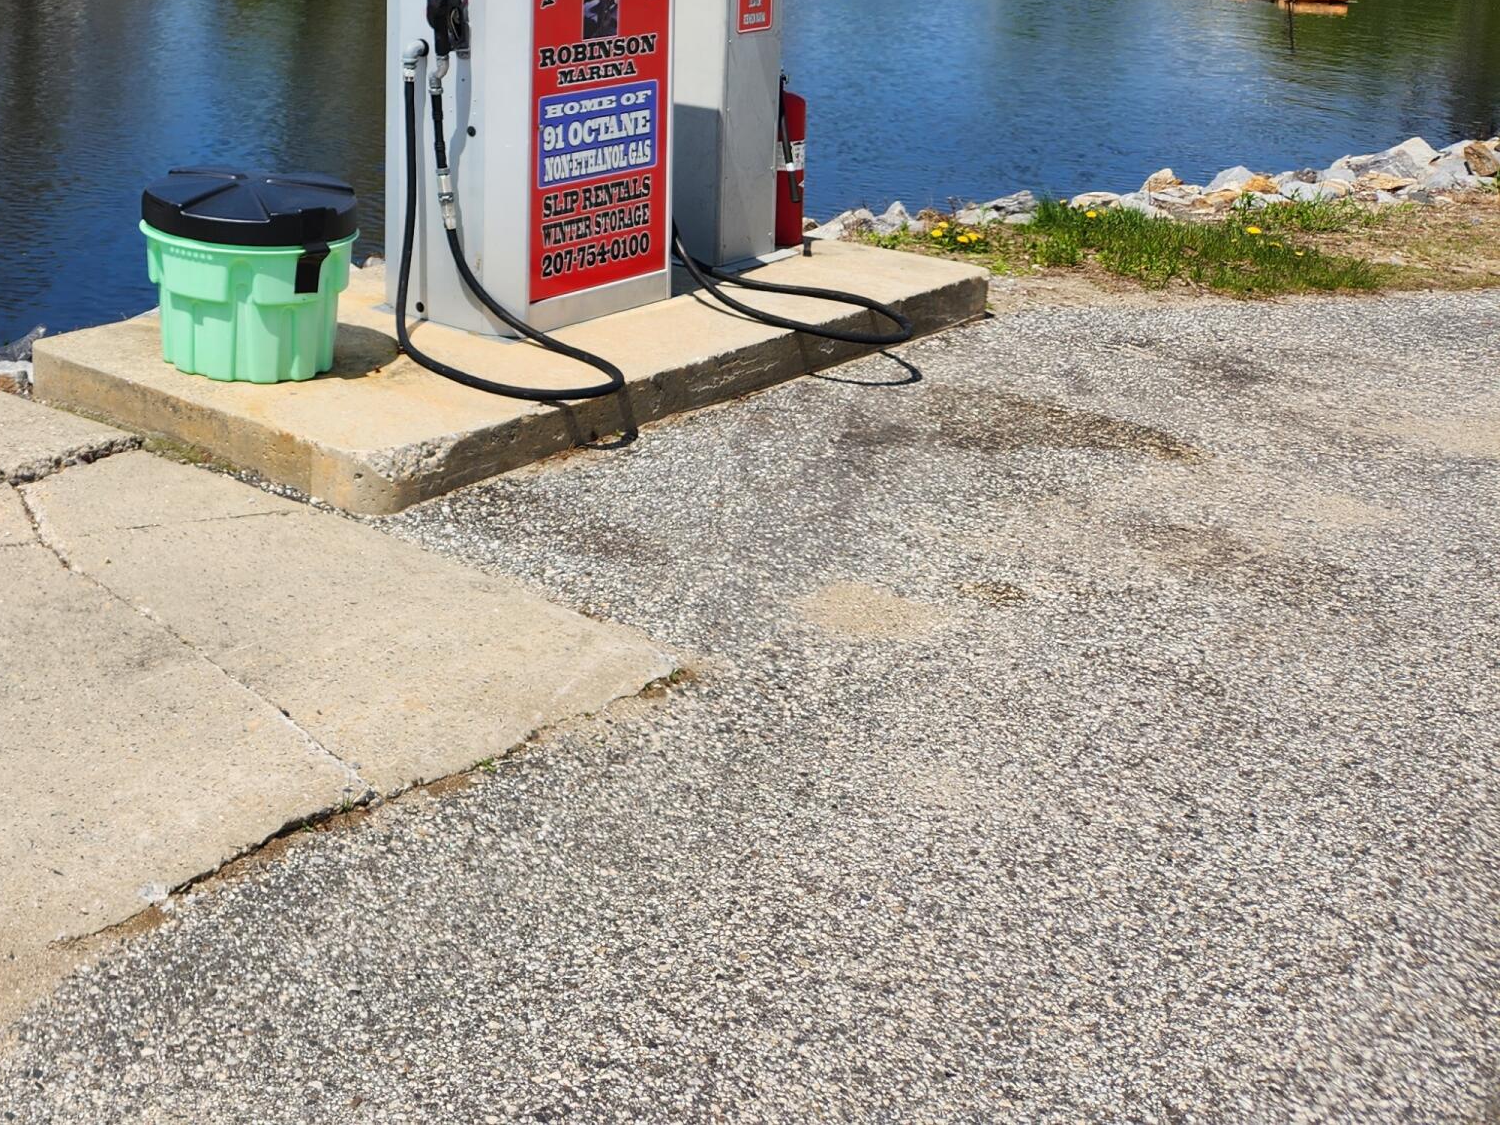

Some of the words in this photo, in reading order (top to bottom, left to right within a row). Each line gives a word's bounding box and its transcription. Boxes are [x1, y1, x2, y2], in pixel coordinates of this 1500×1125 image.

[539, 34, 657, 68] ROBINSON
[557, 60, 636, 87] MARINA
[545, 96, 617, 119] HOME
[620, 90, 652, 105] OF
[543, 125, 565, 151] 91
[568, 109, 650, 146] OCTANE
[544, 144, 627, 182] NON-ETHANOL
[628, 139, 651, 165] GAS
[543, 190, 579, 218] SLIP
[582, 174, 651, 211] RENTALS
[542, 215, 592, 248] WINTER
[595, 202, 650, 235] STORAGE
